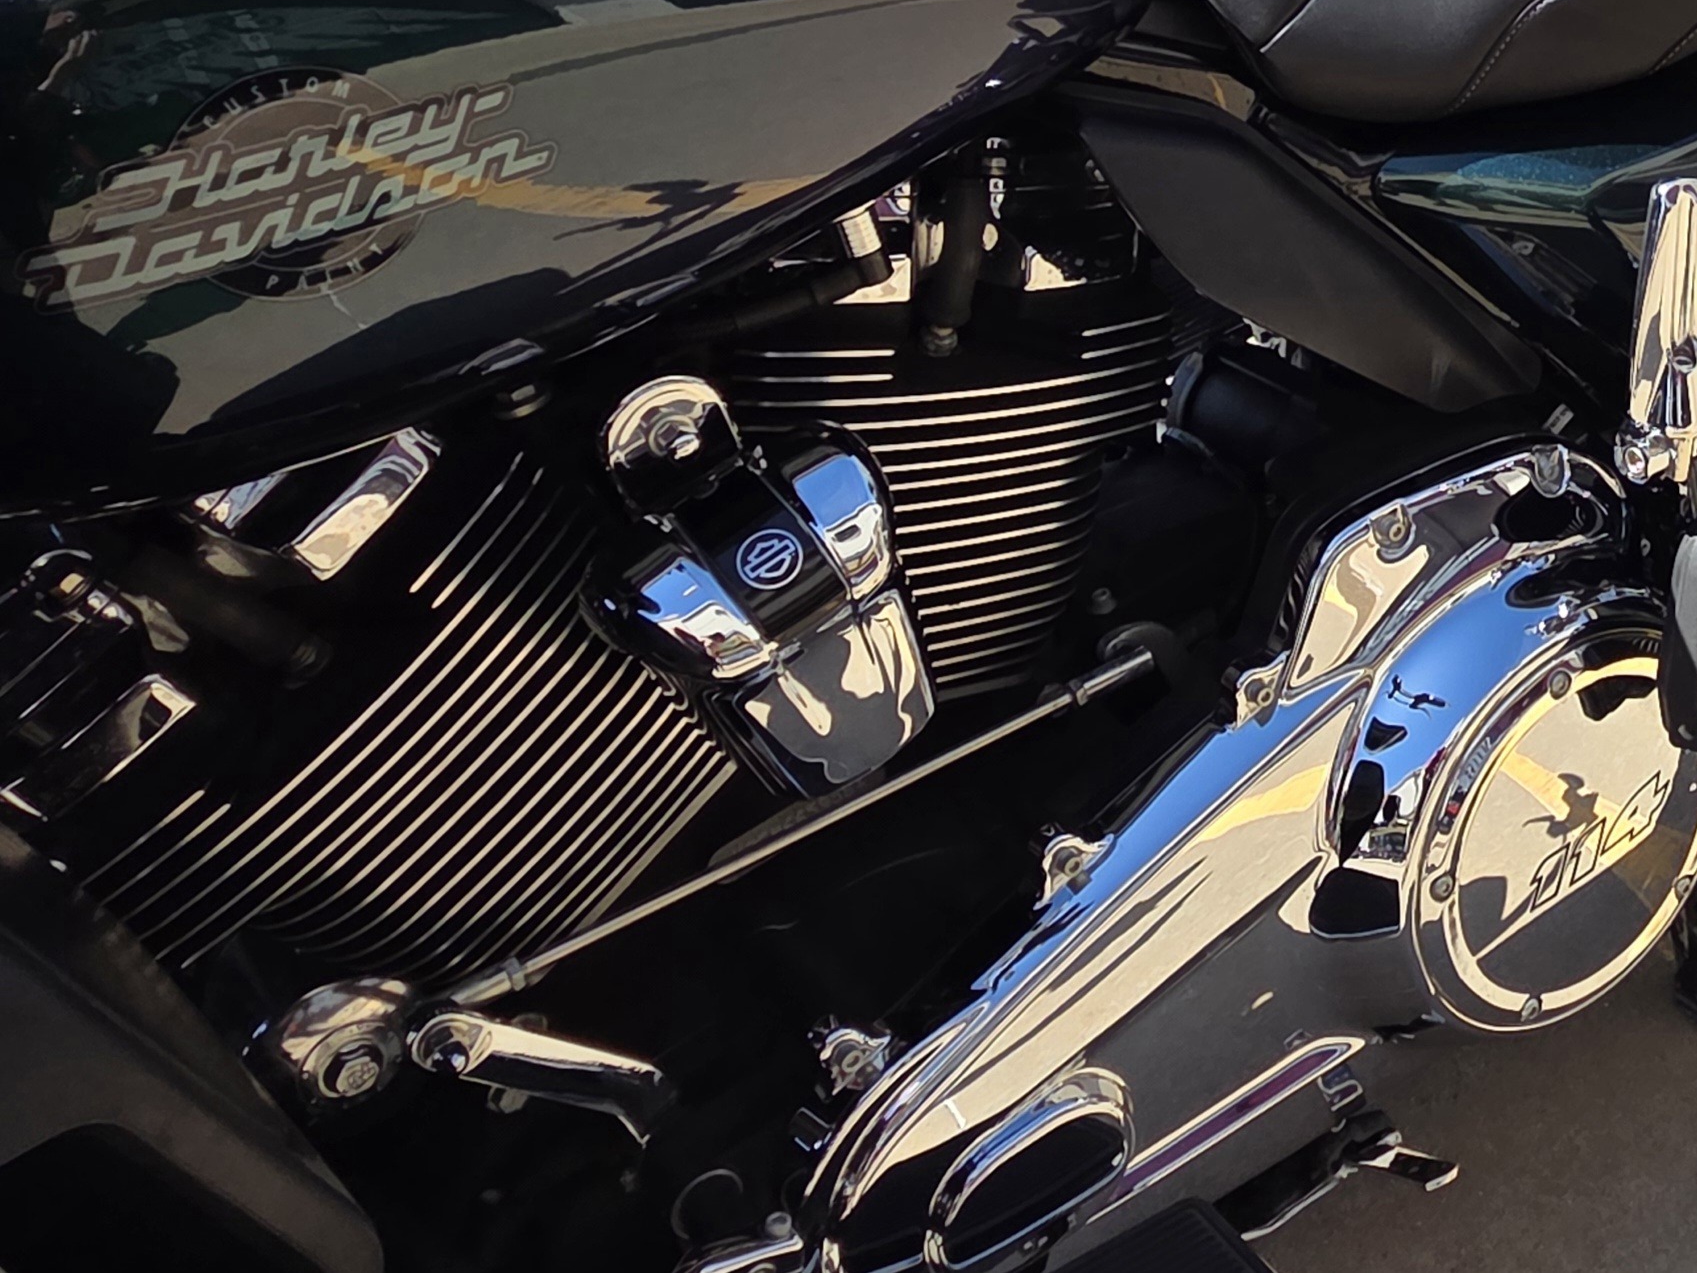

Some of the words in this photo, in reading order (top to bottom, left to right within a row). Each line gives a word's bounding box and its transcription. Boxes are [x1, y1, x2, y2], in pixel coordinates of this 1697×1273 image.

[203, 76, 351, 129] CUSTOM
[26, 137, 549, 305] Davidson
[1531, 771, 1670, 911] 114
